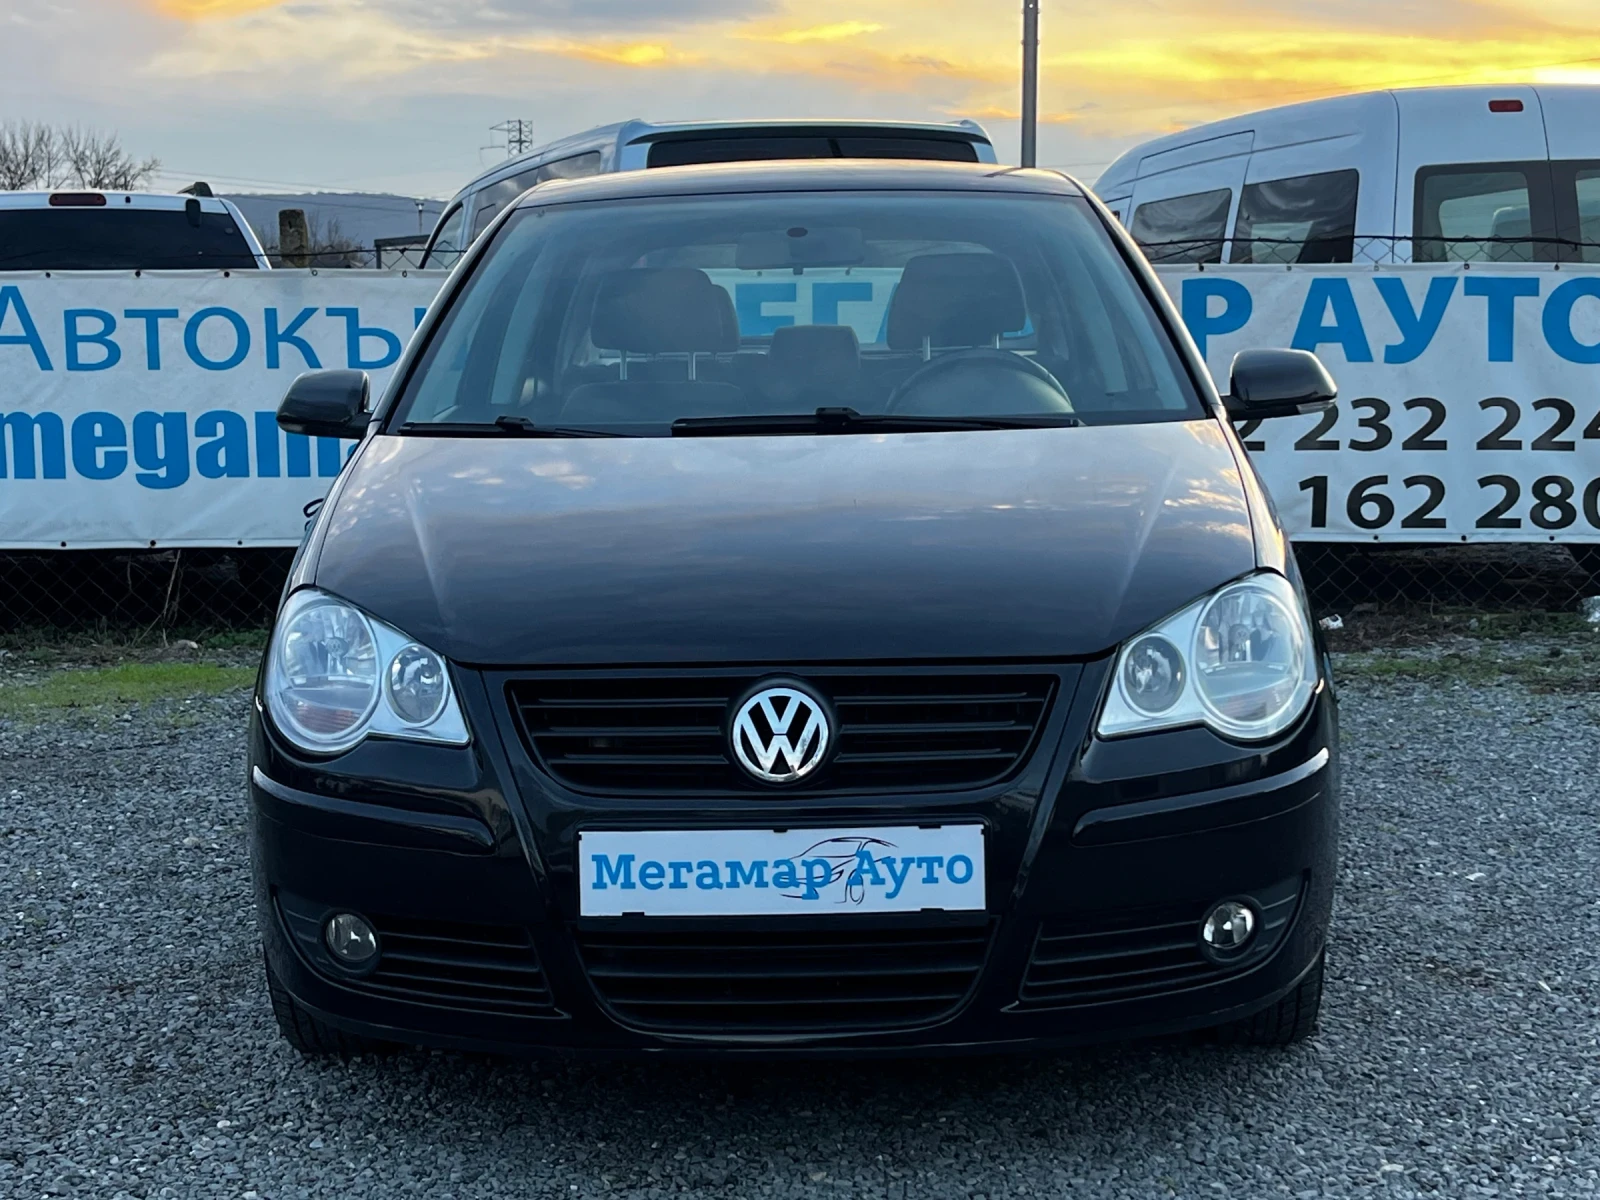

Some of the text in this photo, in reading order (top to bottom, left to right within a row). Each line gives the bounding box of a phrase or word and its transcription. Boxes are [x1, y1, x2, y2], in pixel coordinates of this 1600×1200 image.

[0, 285, 426, 371] Автокъ
[1290, 276, 1600, 364] АУТО
[0, 410, 357, 489] megam
[1294, 397, 1448, 452] 232
[1298, 474, 1447, 530] 162
[737, 689, 826, 779] VW
[591, 850, 974, 900] Мегамар Ауто
